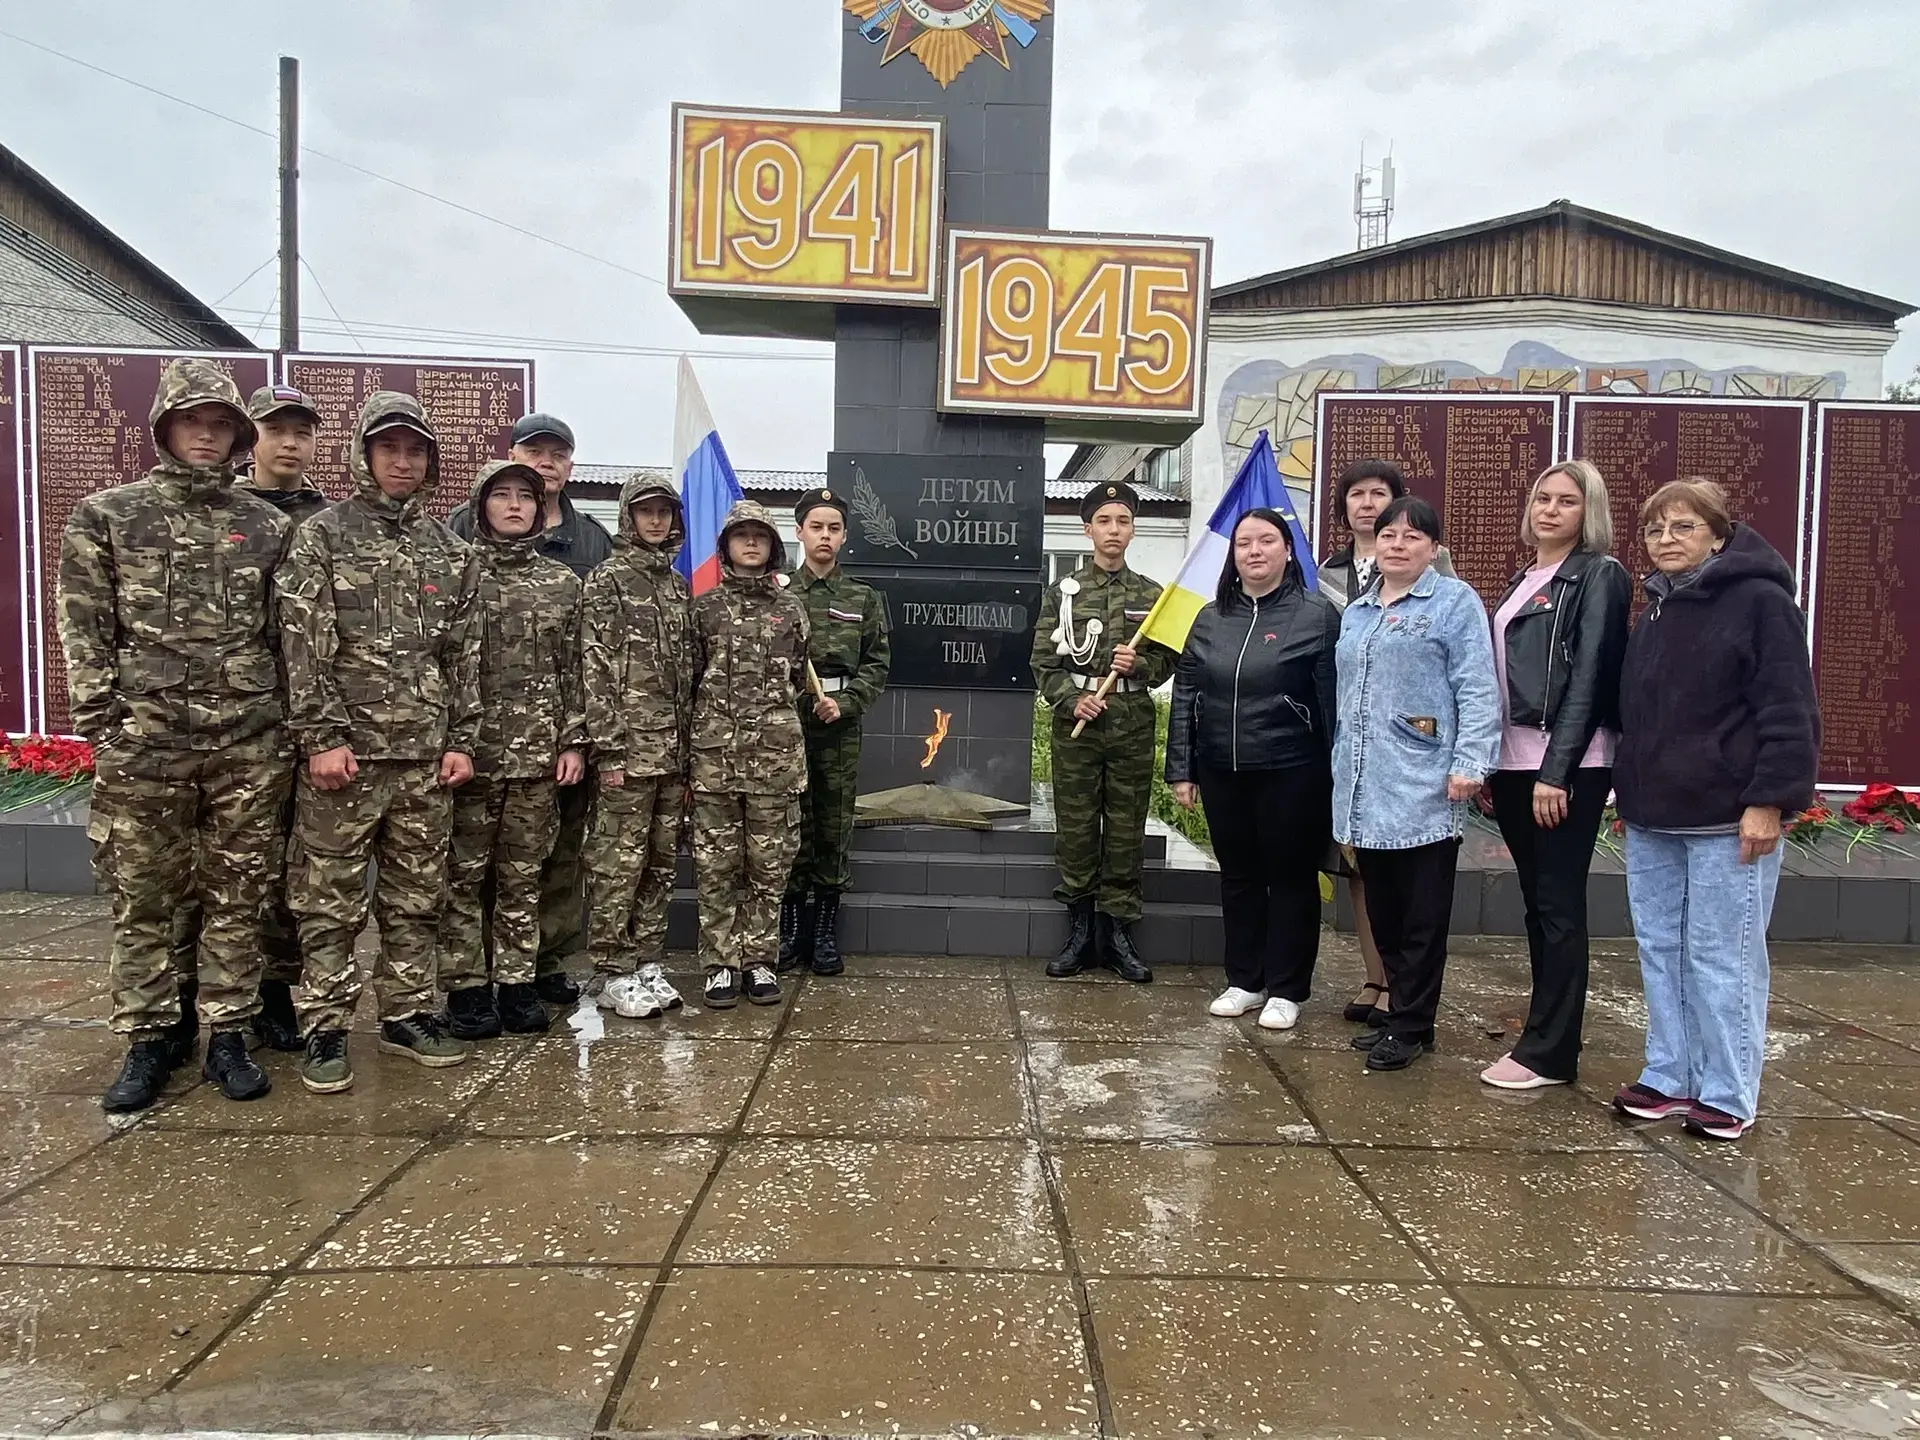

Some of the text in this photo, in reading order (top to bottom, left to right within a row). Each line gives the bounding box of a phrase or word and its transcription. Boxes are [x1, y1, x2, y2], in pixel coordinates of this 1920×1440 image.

[695, 135, 922, 277] 1941
[955, 255, 1192, 394] 1945
[40, 356, 98, 365] КЛЕПИКОВ
[40, 364, 78, 373] КЛЮЕВ
[294, 365, 355, 376] СОДНОМОВ
[41, 373, 84, 382] КОЗЛОВ
[294, 375, 353, 385] СТЕПАНОВ
[41, 382, 85, 391] КОЗЛОВ
[416, 379, 494, 390] ЩЕРБАЧЕНКО
[41, 391, 85, 400] КОЗЛОВ
[416, 388, 480, 398] ЭРДЫНЕЕВ
[424, 408, 480, 416] РДЫНЕЕВ
[1678, 411, 1728, 420] КОПЫЛОВ
[41, 418, 95, 426] КОЛЕСОВ
[1447, 416, 1528, 425] ВЕТОШНИКОВ
[41, 427, 116, 435] КОМИССАРОВ
[1331, 423, 1395, 433] АЛЕКСЕЕВ
[1447, 425, 1503, 434] ВИЛЬМОВ
[41, 435, 116, 444] КОМИССАРОВ
[1331, 433, 1395, 442] АЛЕКСЕЕВ
[1447, 434, 1486, 442] ВИЧИН
[42, 444, 113, 453] КОНДРАТЬЕВ
[1331, 442, 1394, 451] АЛЕКСЕЕВ
[1447, 443, 1510, 452] ВИШНЯКОВ
[42, 453, 114, 461] КОНДРАШКИН
[1446, 452, 1510, 460] ВИШНЯКОВ
[42, 462, 115, 470] КОНДРАШКИН
[1446, 460, 1510, 469] ВИШНЯКОВ
[42, 470, 123, 480] КОНОВАЛЕНКО
[1446, 470, 1502, 479] ВОЛОДИН
[1446, 479, 1502, 488] ВОРОНИН
[918, 478, 1016, 507] ДЕТЯМ
[1445, 488, 1517, 497] ВСТАВСКАЯ
[1445, 497, 1517, 506] ВСТАВСКИЙ
[1444, 506, 1517, 515] ВСТАВСКИЙ
[1444, 515, 1517, 524] ВСТАВСКИЙ
[914, 510, 1019, 546] ВОЙНЫ
[1451, 553, 1505, 561] АВРИЛОВ
[903, 602, 1013, 629] ТРУЖЕНИКАМ
[942, 641, 987, 664] ТЫЛА
